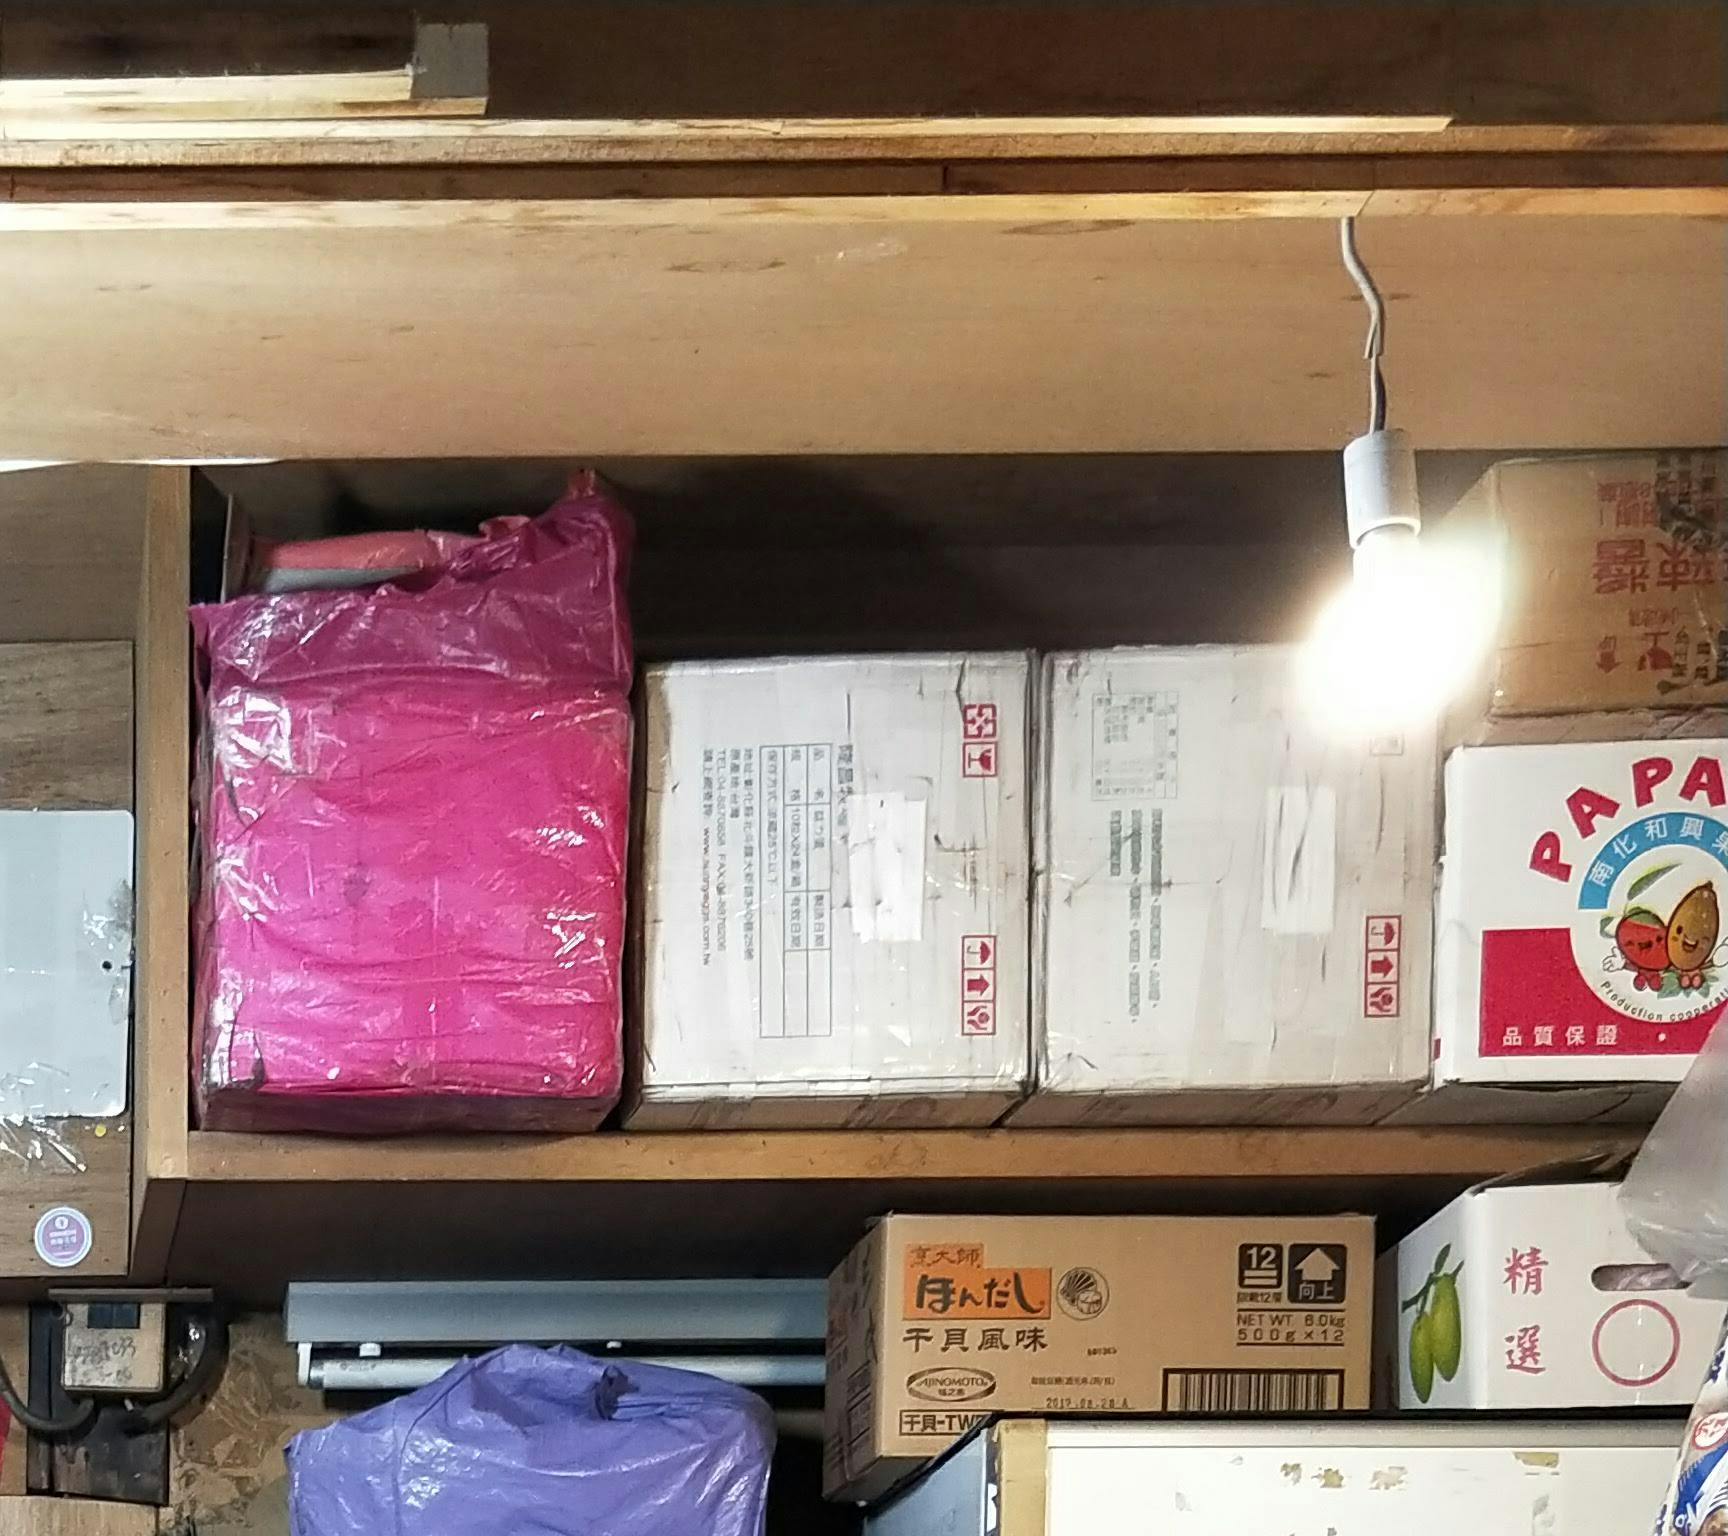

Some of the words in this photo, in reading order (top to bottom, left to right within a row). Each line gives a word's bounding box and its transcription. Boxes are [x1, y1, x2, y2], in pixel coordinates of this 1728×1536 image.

[1502, 1024, 1620, 1049] 品質保證
[1246, 1249, 1276, 1270] 12
[916, 1272, 1044, 1314] ほんだし
[1298, 1281, 1335, 1302] 向上
[1237, 1315, 1264, 1327] NET
[1270, 1315, 1292, 1327] WT
[1503, 1246, 1547, 1375] 精選
[902, 1327, 1049, 1354] 干貝風味
